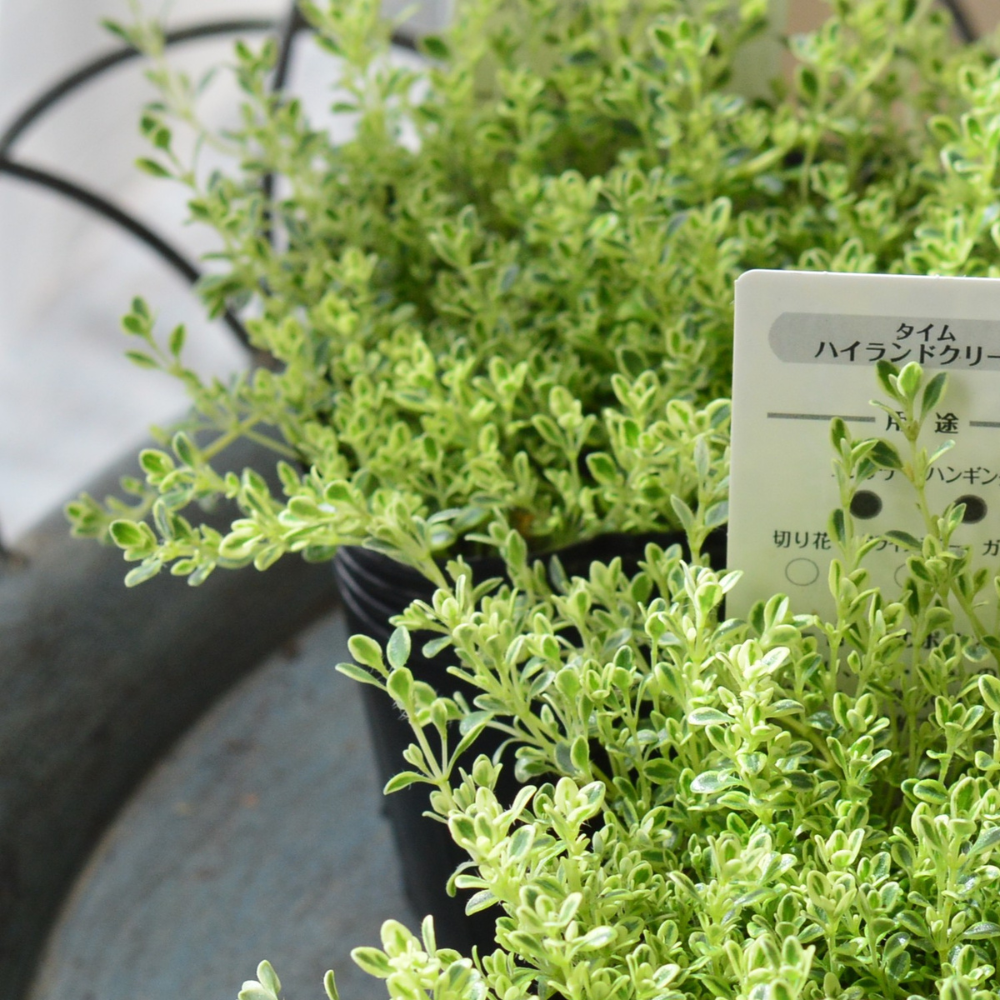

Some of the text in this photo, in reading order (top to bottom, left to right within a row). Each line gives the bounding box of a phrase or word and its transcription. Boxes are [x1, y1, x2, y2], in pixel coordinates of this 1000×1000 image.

[896, 322, 956, 342] タイム
[772, 529, 831, 549] 切り花
